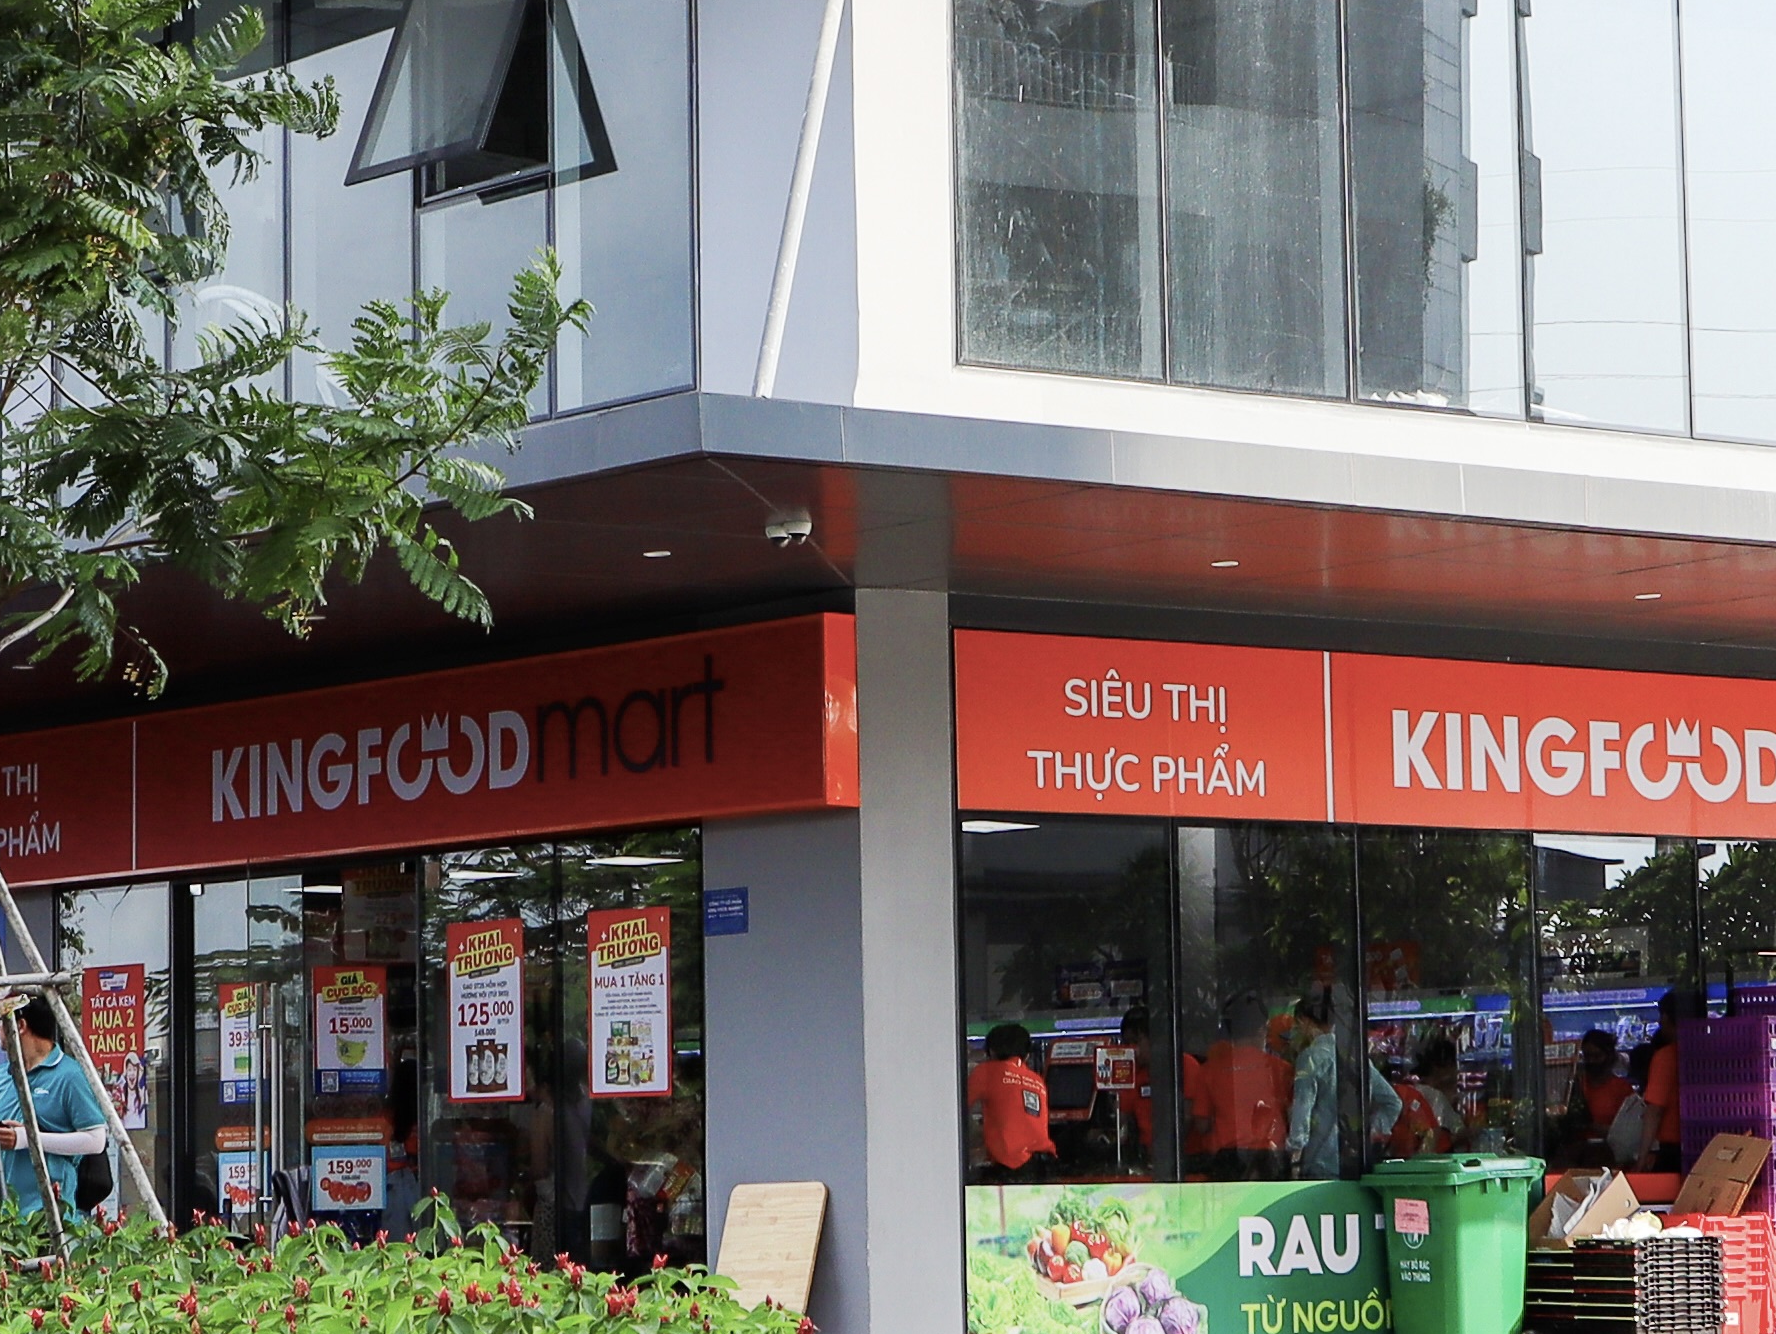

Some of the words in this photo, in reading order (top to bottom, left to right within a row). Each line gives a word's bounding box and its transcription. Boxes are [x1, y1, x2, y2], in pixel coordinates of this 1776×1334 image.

[1064, 668, 1152, 719] SIÊU
[1162, 684, 1227, 733] THỊ
[1027, 747, 1140, 801] THỰC
[1152, 742, 1266, 797] PHẨM
[1, 763, 39, 803] THỊ
[611, 920, 645, 942] KHAI
[468, 931, 500, 953] KHAI
[340, 973, 358, 985] GIÁ
[595, 976, 617, 988] MUA
[621, 976, 625, 987] 1
[660, 973, 664, 985] 1
[90, 995, 104, 1008] TẤT
[118, 995, 135, 1007] KEM
[92, 1010, 123, 1029] MUA
[126, 1009, 134, 1027] 2
[457, 1000, 514, 1027] 125.000
[329, 1017, 372, 1034] 15.000
[130, 1033, 137, 1051] 1
[327, 1159, 372, 1175] 159.000
[1238, 1213, 1361, 1277] RAU
